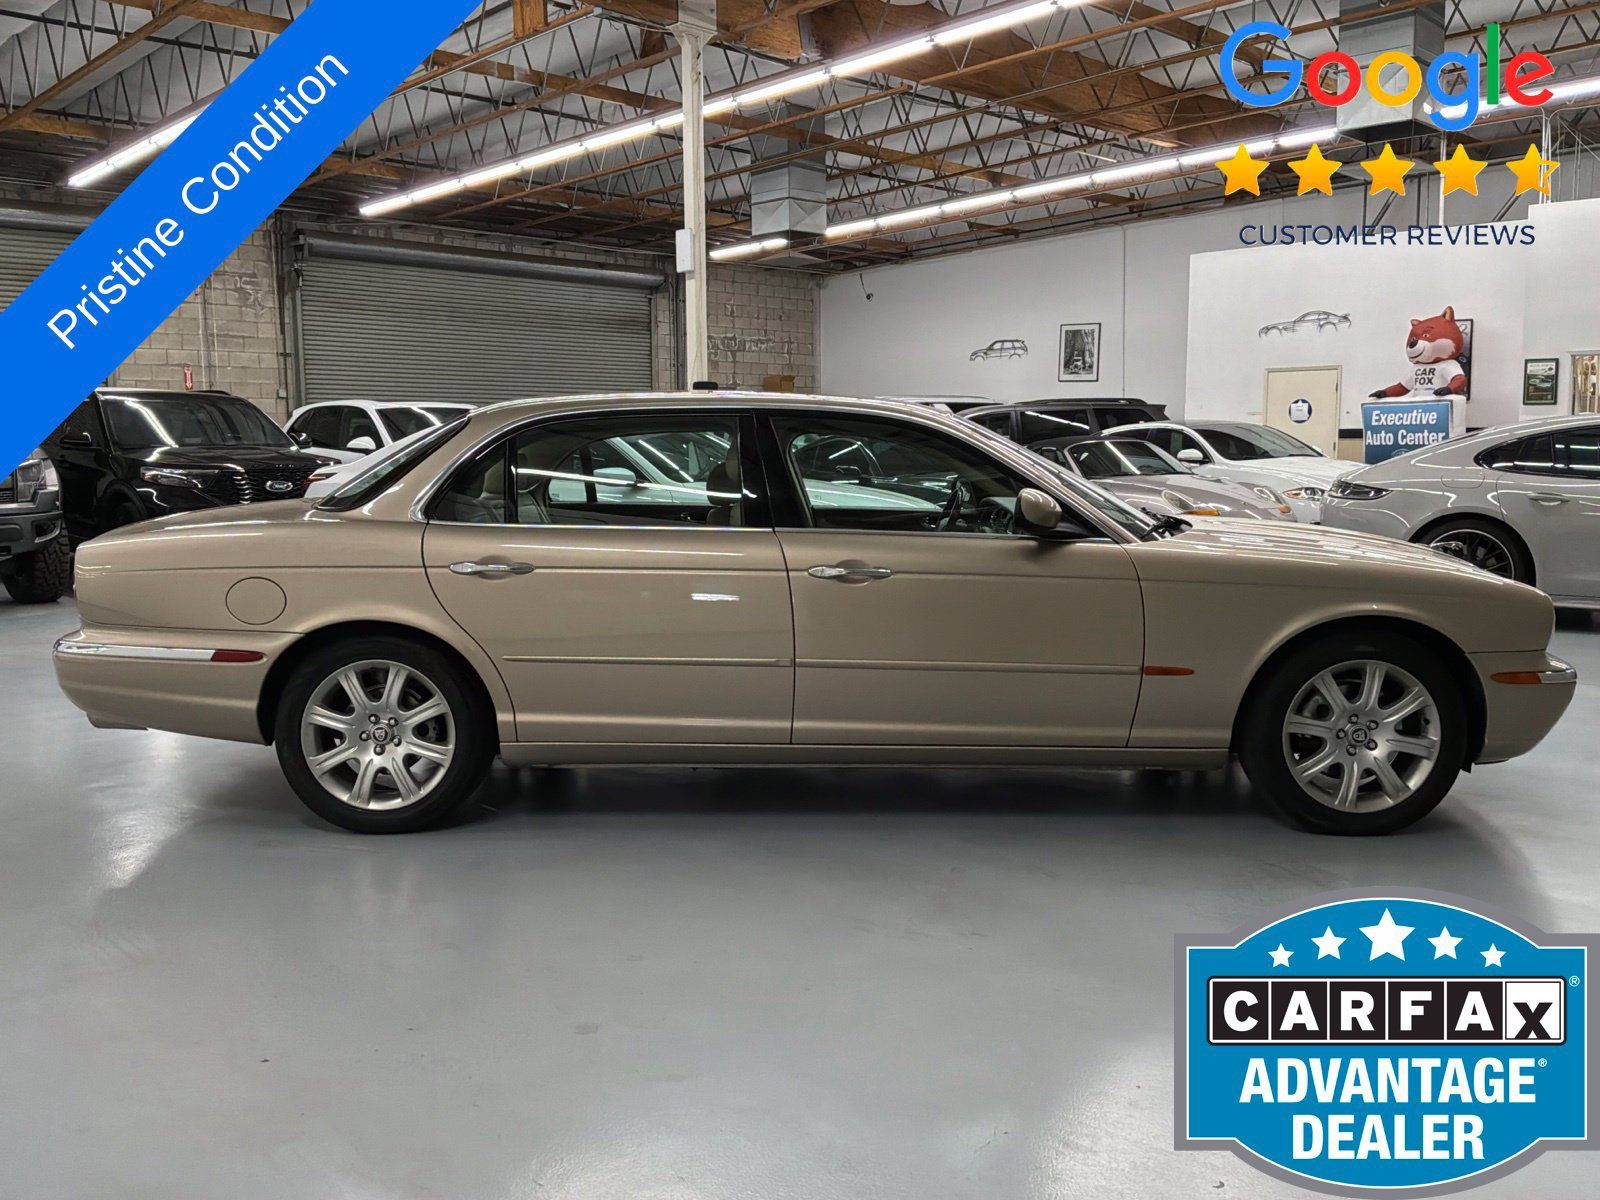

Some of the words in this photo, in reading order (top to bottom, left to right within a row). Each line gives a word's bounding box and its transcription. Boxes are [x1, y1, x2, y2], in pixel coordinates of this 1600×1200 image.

[1414, 367, 1436, 377] CAR
[1414, 376, 1435, 386] FOX
[1371, 409, 1437, 426] Executive
[1366, 431, 1394, 446] Auto
[1397, 429, 1446, 446] Center
